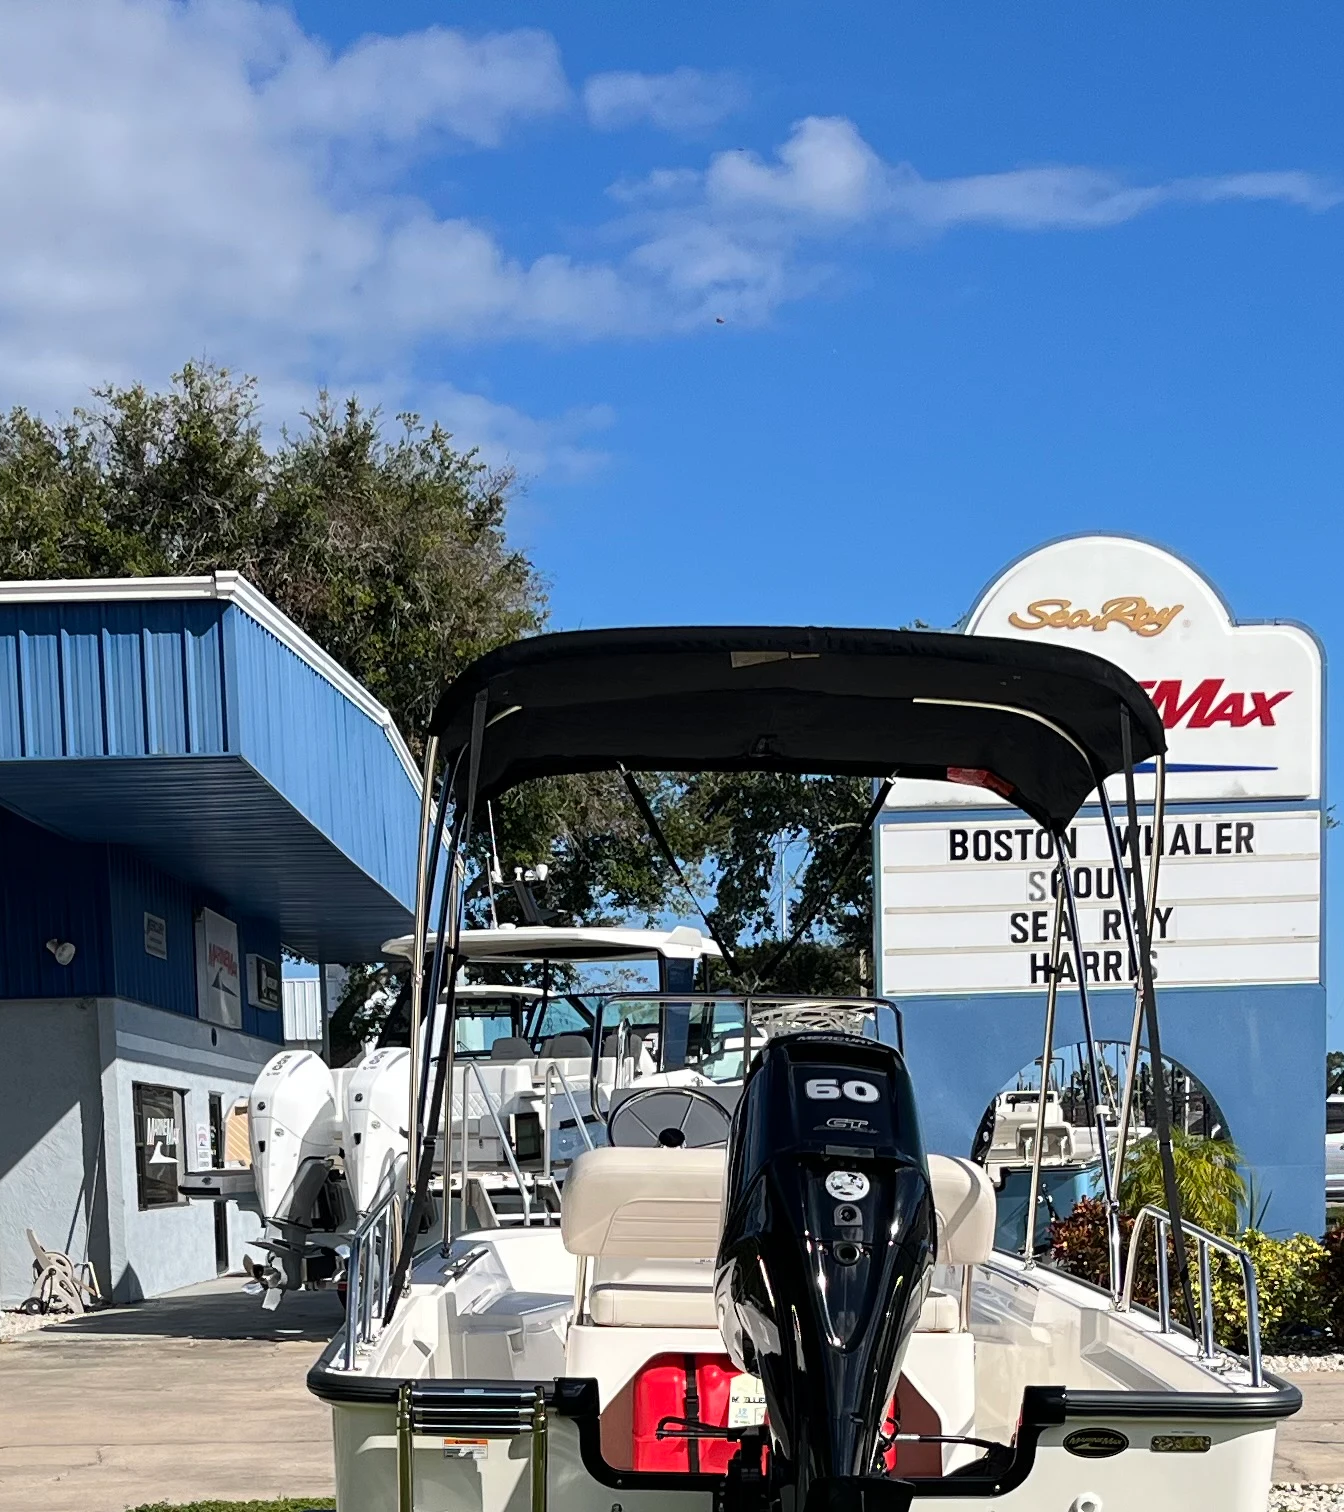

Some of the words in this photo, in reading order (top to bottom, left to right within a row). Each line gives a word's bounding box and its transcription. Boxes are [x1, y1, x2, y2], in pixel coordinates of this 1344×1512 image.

[949, 827, 1077, 861] BOSTON
[1115, 822, 1254, 857] WHALER
[1010, 910, 1073, 944] SEA
[796, 1035, 875, 1045] MERCURY
[805, 1078, 881, 1104] 60
